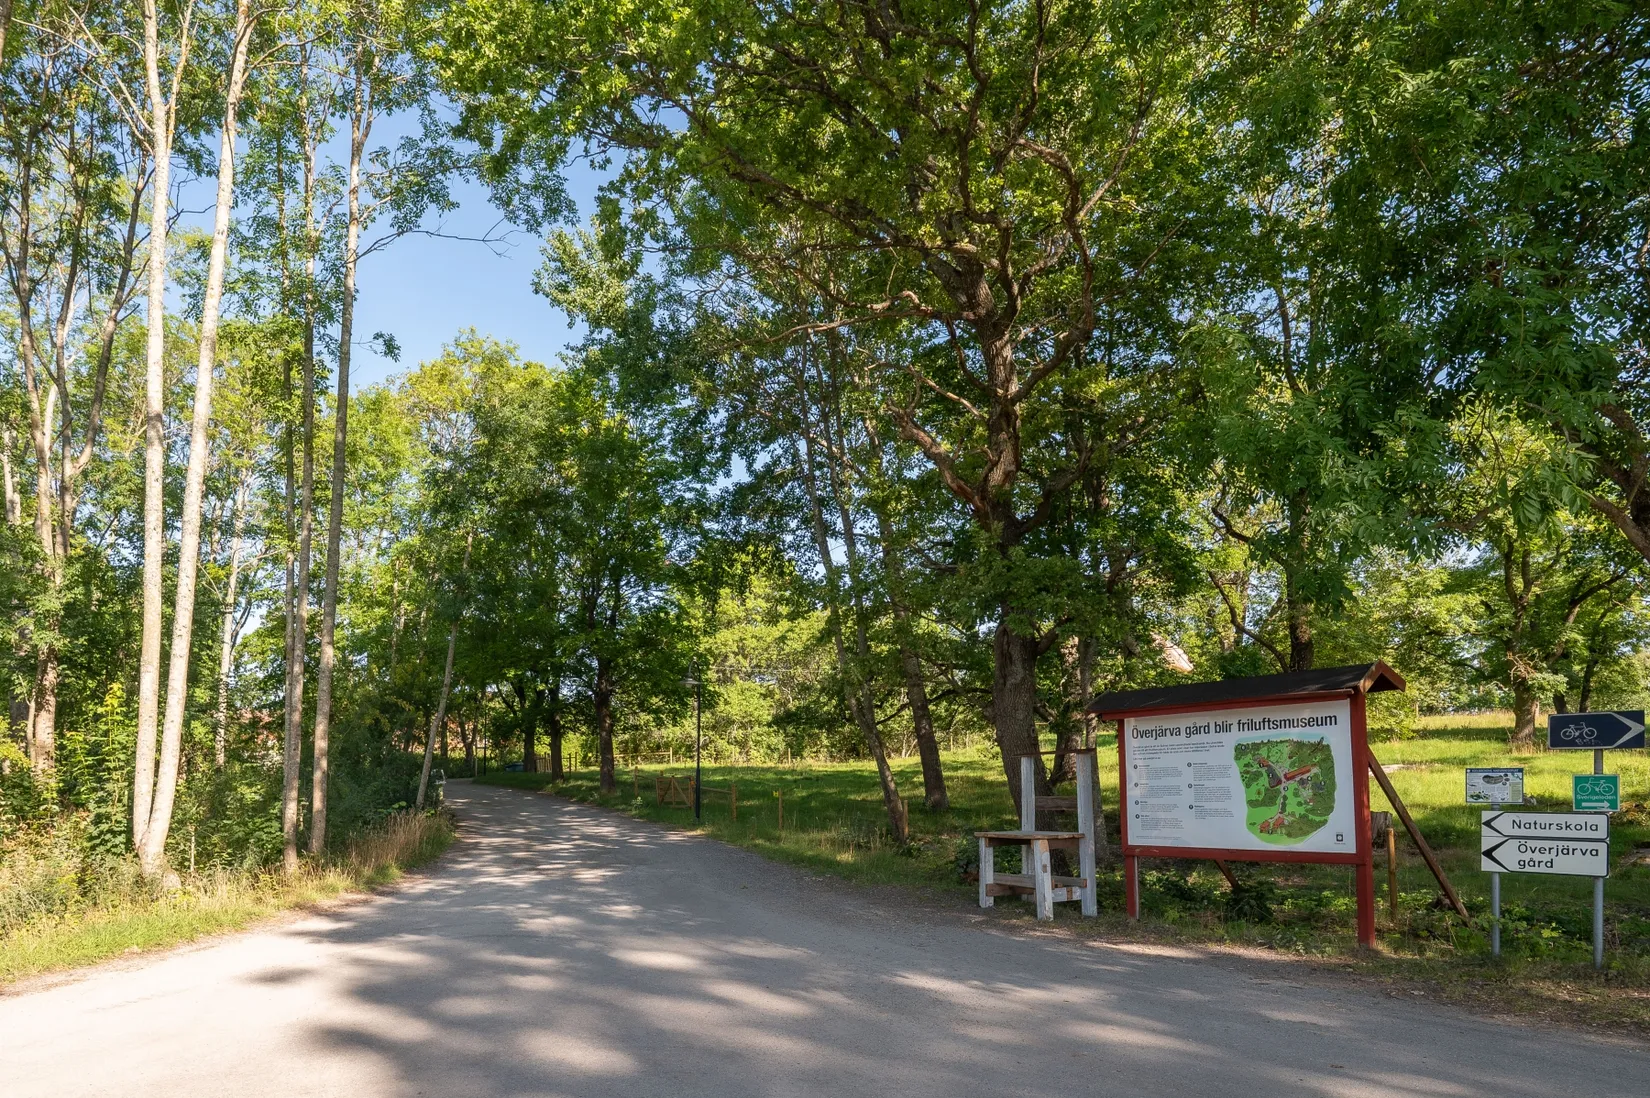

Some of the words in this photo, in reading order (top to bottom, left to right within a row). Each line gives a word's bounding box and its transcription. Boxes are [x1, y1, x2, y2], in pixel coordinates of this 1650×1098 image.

[1131, 725, 1181, 740] Överjärva
[1185, 721, 1210, 738] gård
[1214, 720, 1233, 734] blir
[1237, 714, 1338, 732] friluftsmuseum
[1512, 819, 1599, 832] Naturskola
[1518, 841, 1599, 857] Överjärva
[1518, 857, 1554, 869] gård
